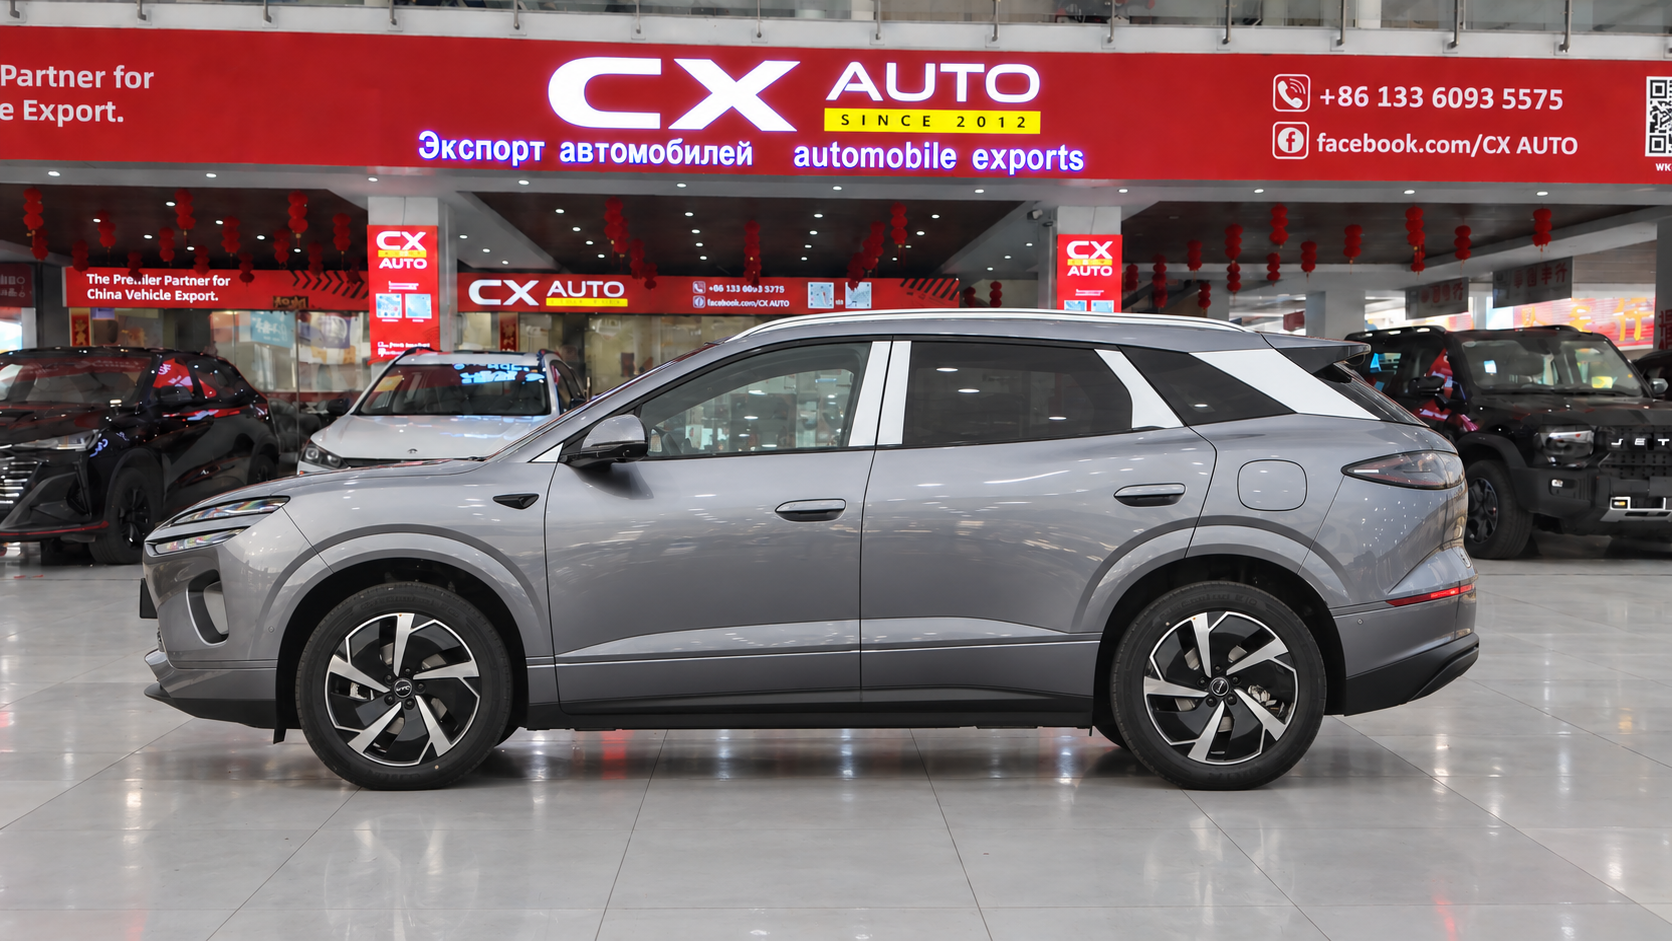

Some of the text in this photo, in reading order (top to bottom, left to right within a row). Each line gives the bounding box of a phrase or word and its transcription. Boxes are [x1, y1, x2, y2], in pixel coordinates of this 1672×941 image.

[0, 64, 154, 89] Partner for
[825, 61, 1041, 104] AUTO
[547, 56, 801, 132] CX
[1319, 85, 1563, 111] +86 133 6093 5575
[23, 99, 124, 128] Export.
[840, 113, 1027, 129] SINCE 2012
[417, 130, 754, 168] Экспорт автомобилей
[1316, 132, 1579, 158] facebook.com/CX AUTO
[793, 140, 1085, 175] automobile exports
[376, 230, 427, 251] CX
[1066, 240, 1113, 259] CX
[378, 257, 428, 270] AUTO
[1067, 265, 1113, 277] AUTO
[86, 273, 110, 285] The
[164, 275, 211, 287] Partner
[212, 274, 231, 287] for
[546, 280, 625, 298] AUTO
[87, 287, 219, 304] China Vehicle Export.
[468, 279, 540, 306] CX
[769, 300, 790, 308] AUTO
